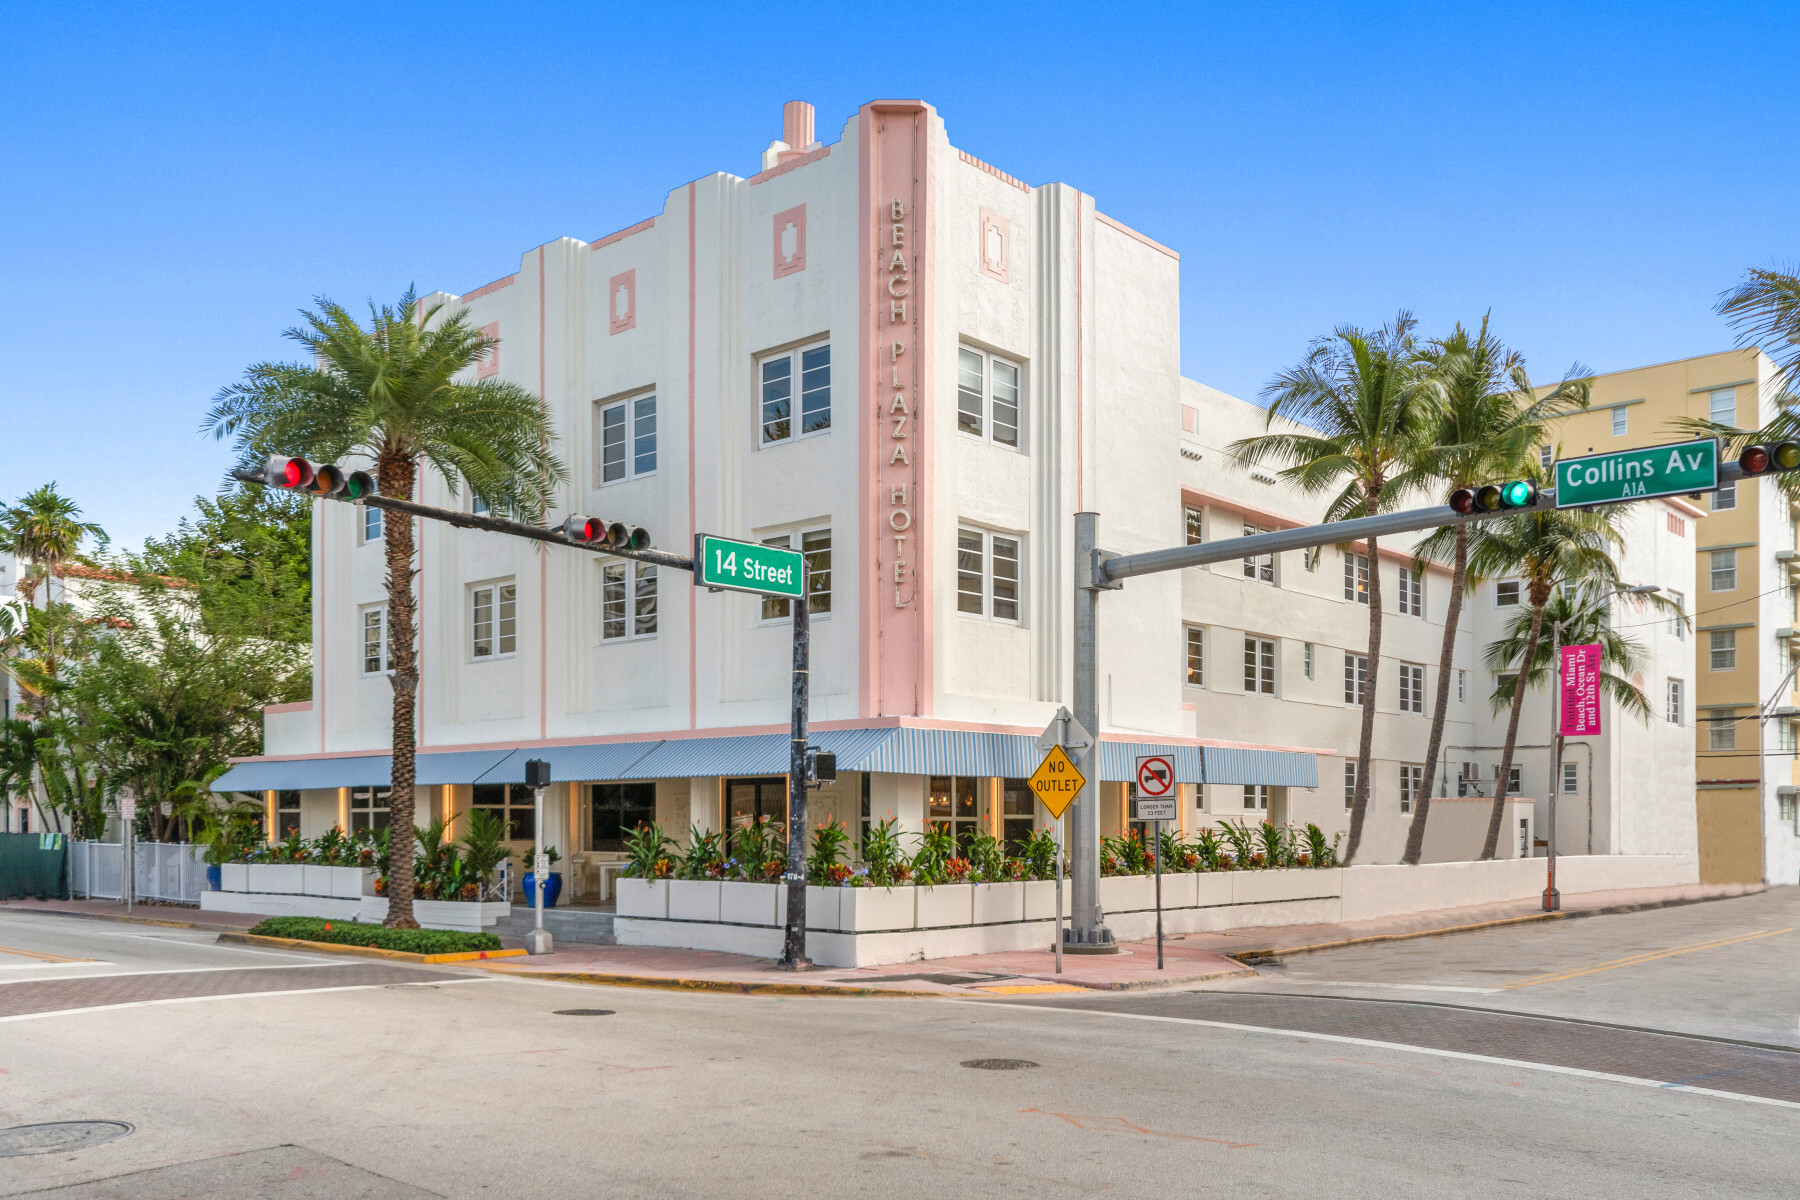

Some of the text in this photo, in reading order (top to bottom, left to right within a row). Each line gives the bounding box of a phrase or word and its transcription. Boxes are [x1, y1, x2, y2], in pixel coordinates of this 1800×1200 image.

[888, 197, 911, 608] BEACH PLAZA HOTEL
[1566, 449, 1704, 487] Collins Av
[1622, 480, 1647, 497] A1A
[715, 549, 793, 585] 14 Street
[1566, 654, 1576, 728] Untitled Miami
[1576, 649, 1586, 731] Beach, Ocean Dr
[1586, 654, 1596, 726] and 12th St Art
[1036, 779, 1078, 792] OUTLET
[1049, 760, 1065, 773] NO
